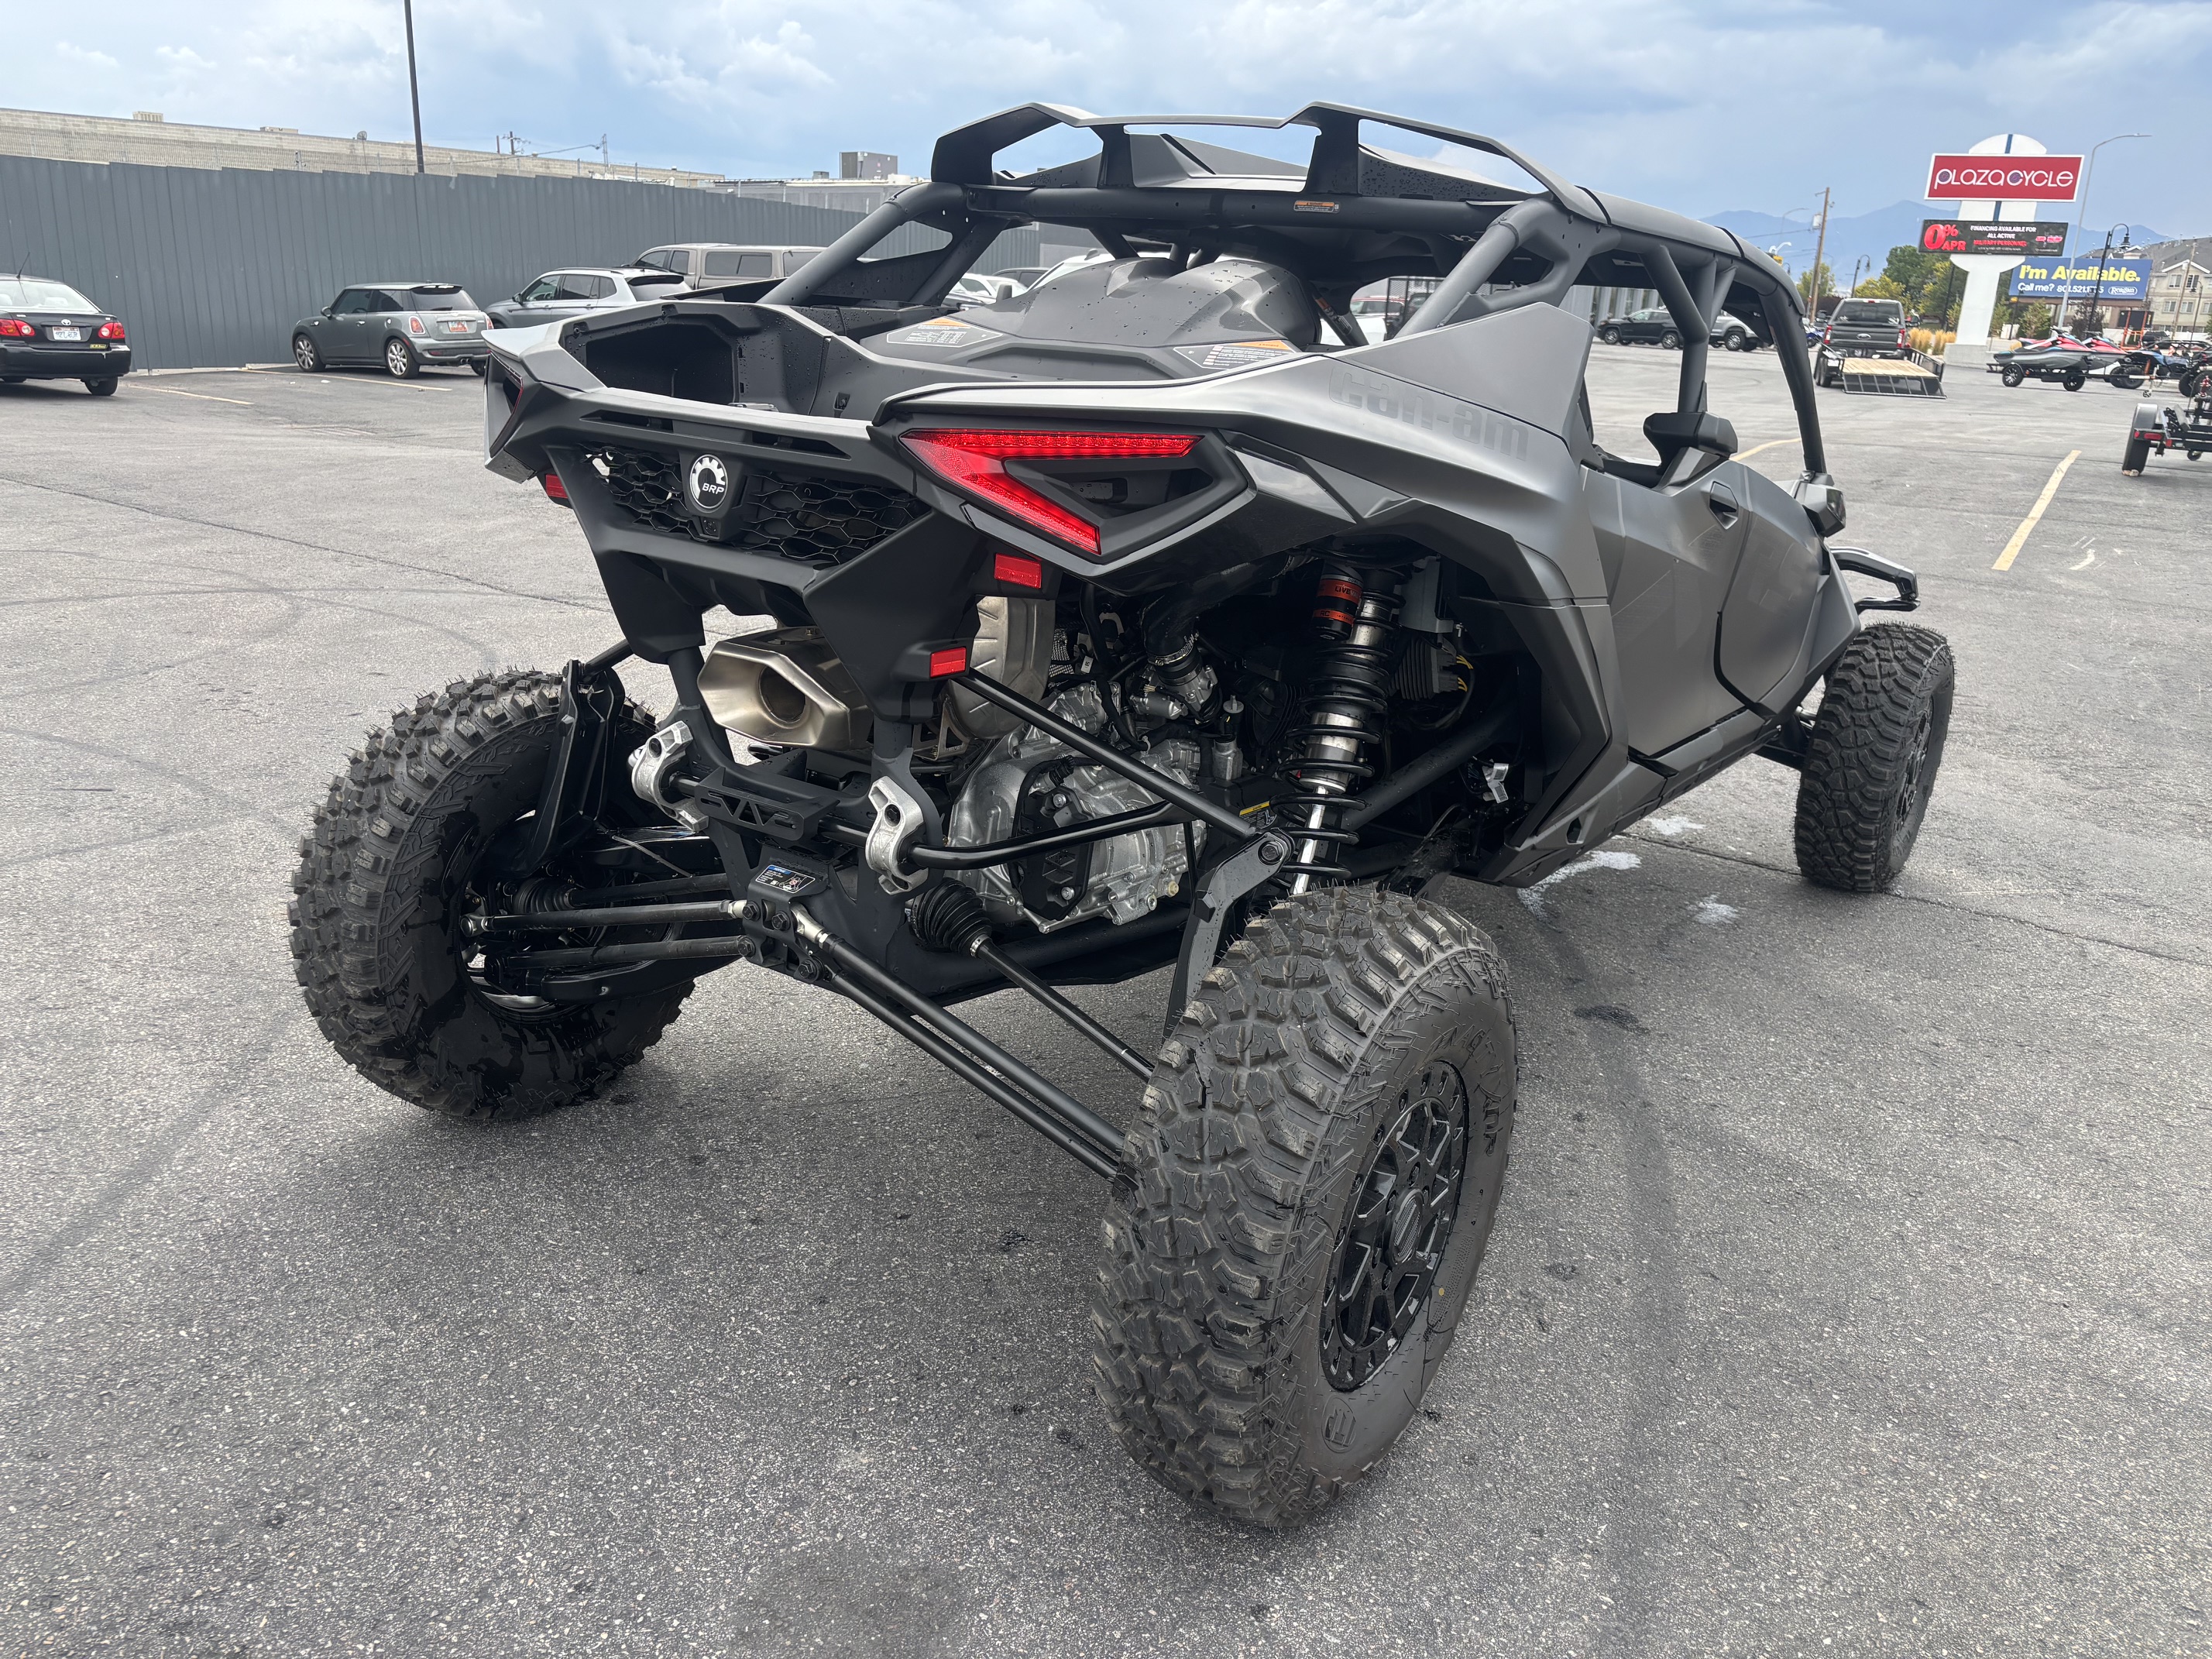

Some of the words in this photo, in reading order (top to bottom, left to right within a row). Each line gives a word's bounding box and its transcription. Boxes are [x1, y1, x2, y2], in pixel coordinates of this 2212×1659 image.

[1942, 241, 1966, 251] APR
[2019, 265, 2048, 279] I'm
[2018, 283, 2035, 291] Call
[2035, 283, 2054, 292] me?
[702, 483, 724, 494] BRP
